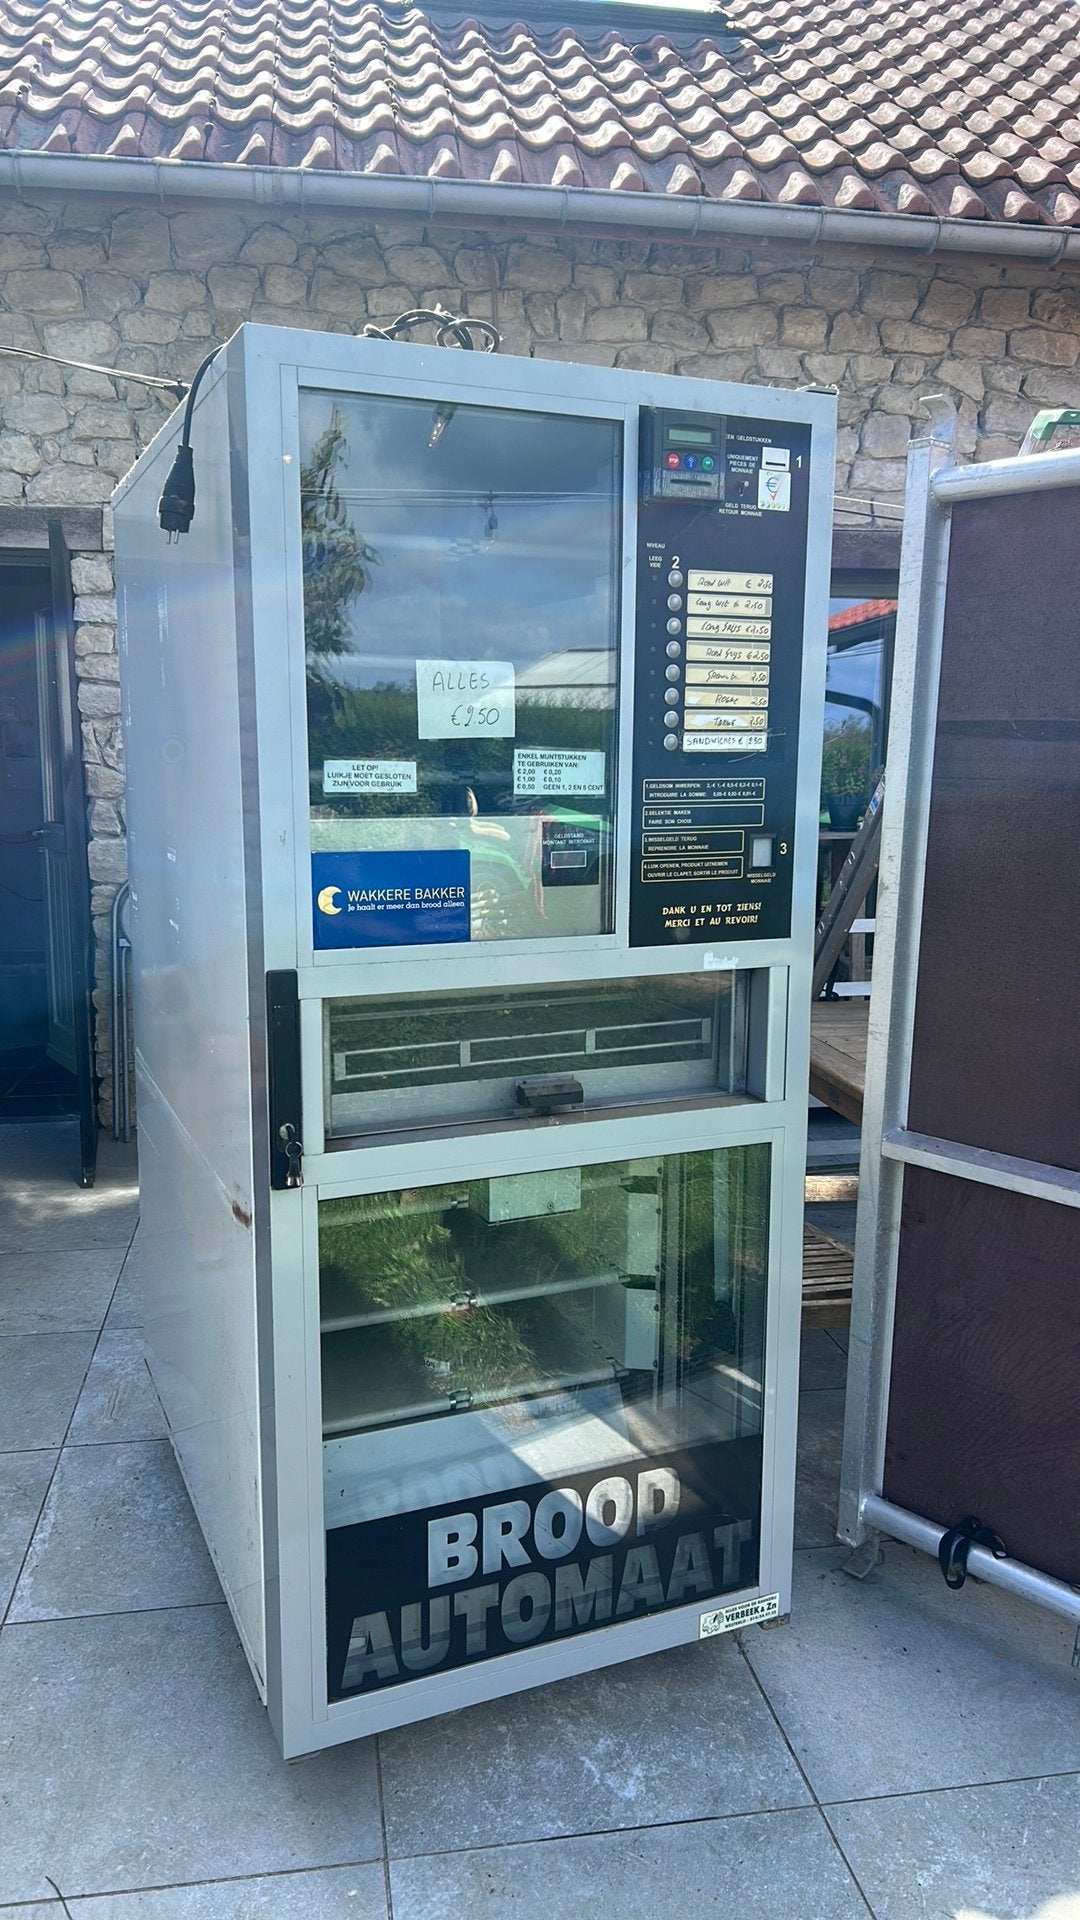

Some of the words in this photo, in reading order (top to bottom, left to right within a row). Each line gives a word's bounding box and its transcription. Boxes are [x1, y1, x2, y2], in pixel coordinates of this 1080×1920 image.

[796, 455, 802, 468] 1
[672, 556, 680, 569] 2
[432, 671, 489, 691] ALLES
[779, 843, 787, 854] 3
[348, 889, 410, 901] WAKKERE
[415, 887, 464, 899] BAKKER
[356, 903, 375, 911] haalt
[422, 900, 441, 908] brood
[662, 906, 685, 915] DANK
[690, 905, 696, 913] U
[716, 904, 732, 912] TOT
[737, 902, 761, 911] ZIENS!
[665, 918, 690, 928] MERCI
[695, 918, 704, 926] ET
[710, 917, 720, 925] AU
[725, 915, 758, 924] REVOIR!
[427, 1466, 681, 1588] BROOD
[341, 1519, 752, 1689] AUTOMAAT
[725, 1607, 760, 1622] VERBEEK
